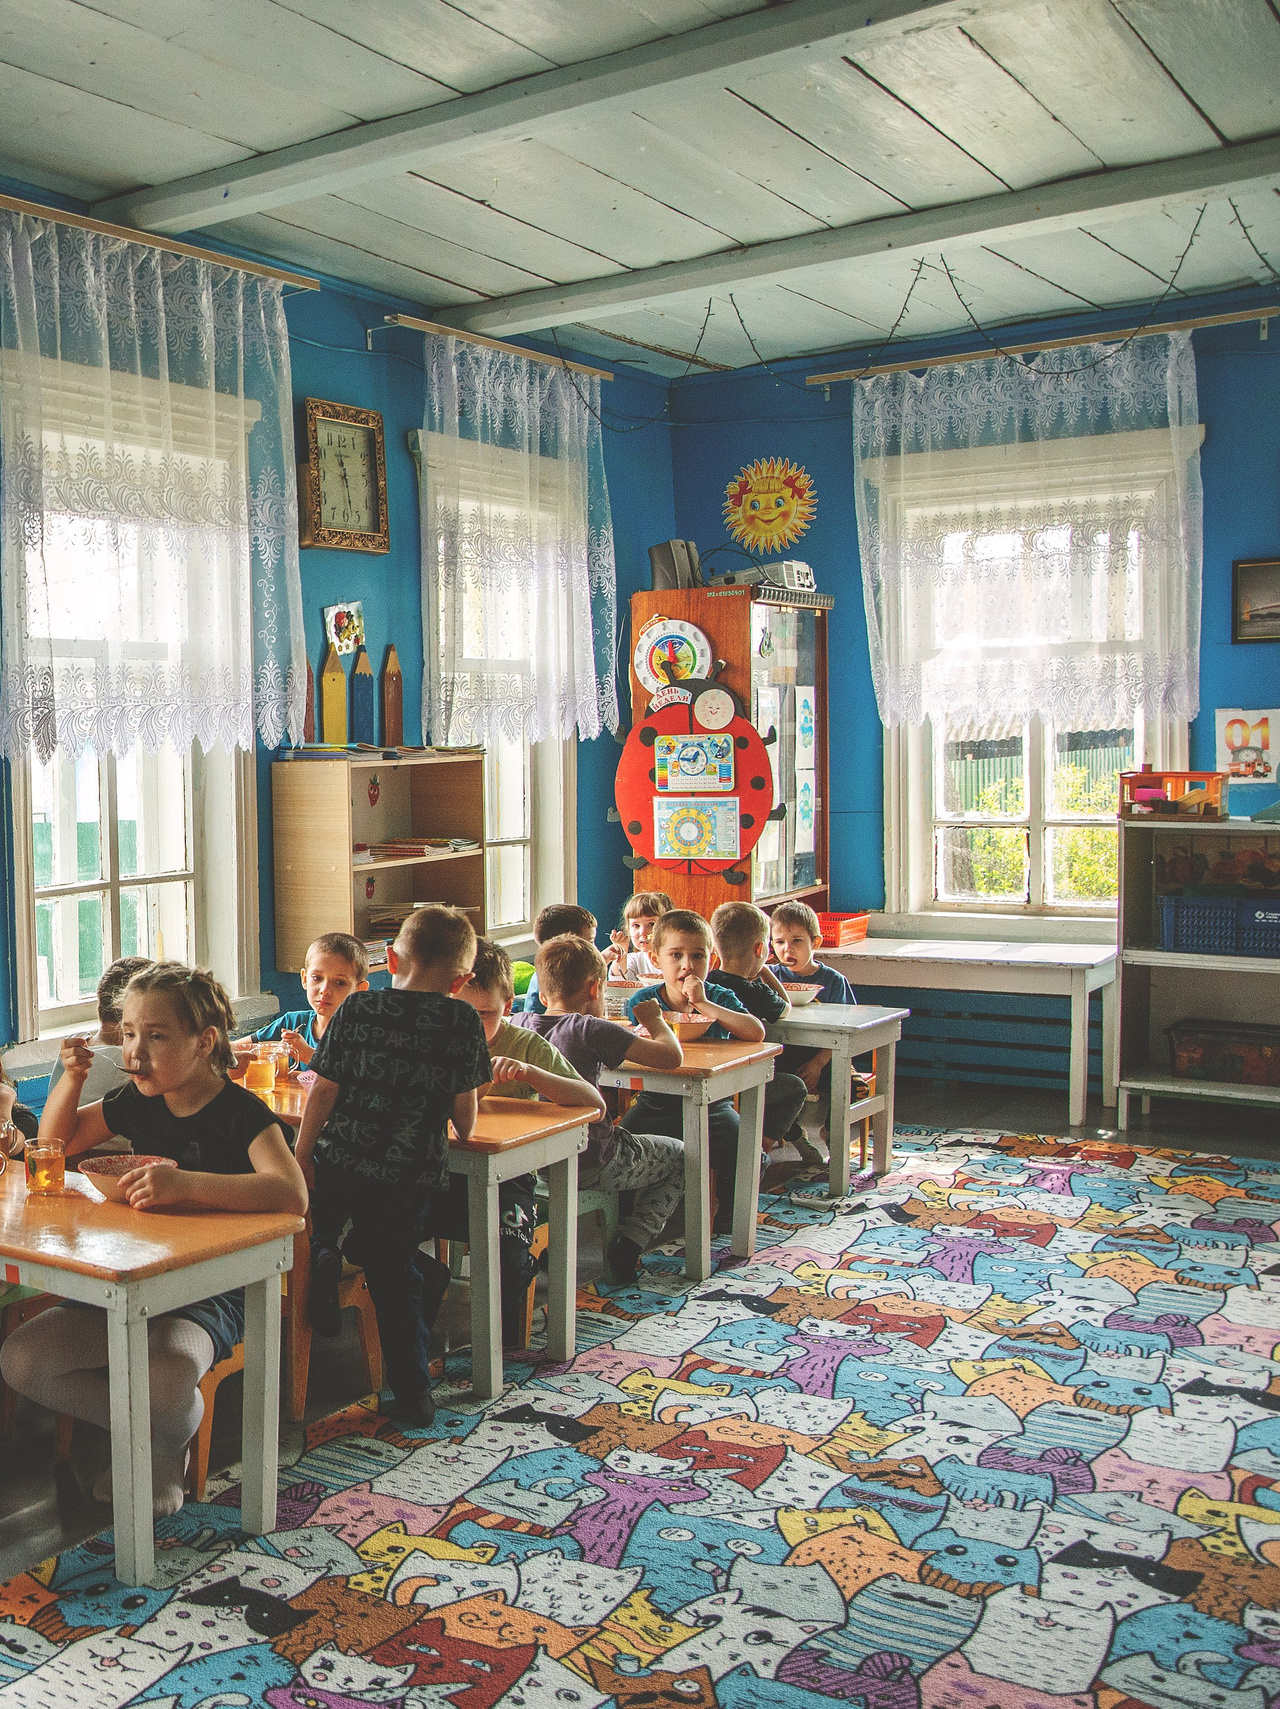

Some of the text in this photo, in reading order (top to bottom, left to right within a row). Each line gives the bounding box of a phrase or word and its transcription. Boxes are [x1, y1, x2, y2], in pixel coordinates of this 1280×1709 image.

[343, 508, 349, 523] 6
[656, 687, 679, 700] ДЕНЬ
[652, 695, 689, 711] НЕДЕЛИ
[1224, 717, 1270, 751] 01
[371, 1026, 432, 1053] PARIS
